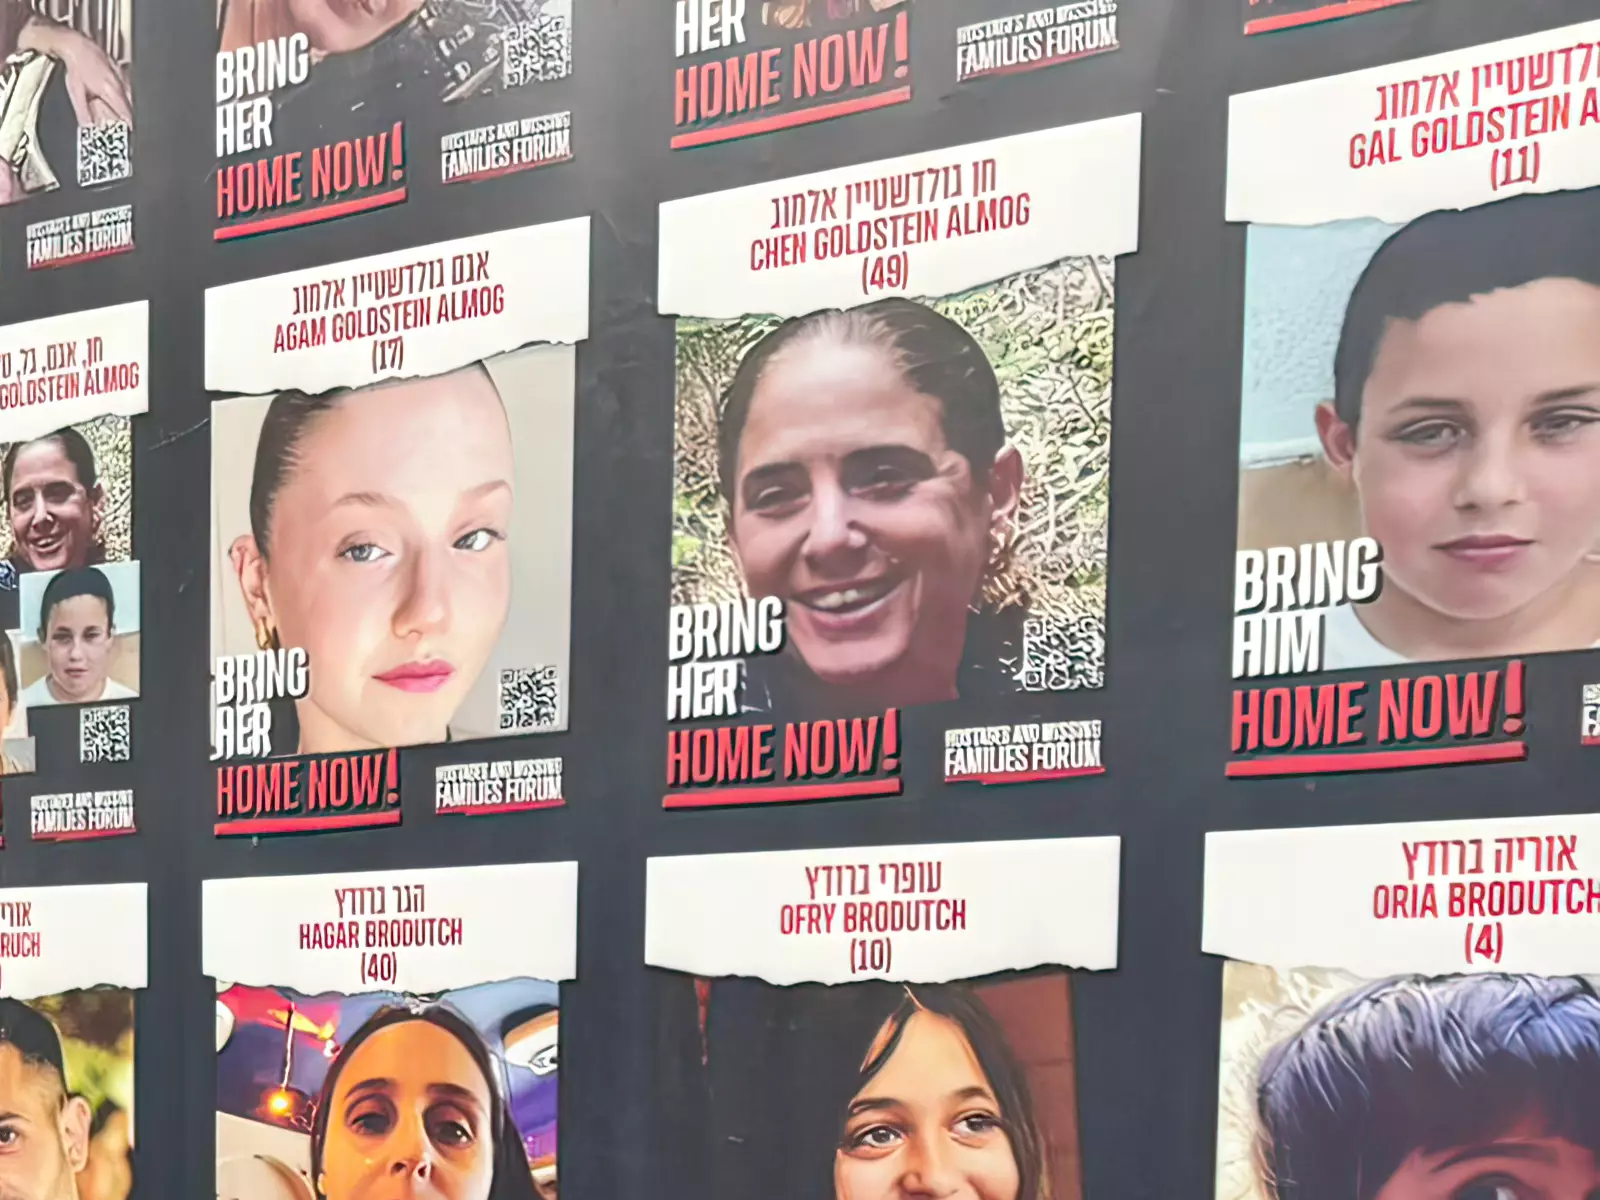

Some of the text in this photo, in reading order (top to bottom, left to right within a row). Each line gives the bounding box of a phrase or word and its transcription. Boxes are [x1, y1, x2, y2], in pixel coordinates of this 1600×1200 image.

[676, 0, 745, 56] HER
[958, 29, 1043, 81] FAMILIES
[1047, 14, 1117, 56] FORUM
[216, 34, 309, 101] BRING
[676, 48, 780, 125] HOME
[795, 13, 908, 95] NOW!
[216, 103, 273, 156] HER
[442, 145, 510, 179] FAMILIES
[512, 130, 570, 165] FORUM
[1349, 94, 1571, 170] GAL GOLDSTEIN
[217, 153, 301, 217] HOME
[313, 122, 405, 200] NOW!
[1490, 142, 1541, 191] (11)
[27, 220, 133, 268] FAMILIES FORUM
[750, 193, 1030, 271] CHEN GOLDSTEIN ALMOG
[861, 251, 909, 294] (49)
[273, 284, 505, 353] AGAM GOLDSTEIN ALMOG
[83, 361, 140, 396] ALMOG
[371, 335, 404, 373] (17)
[1236, 537, 1381, 612] BRING
[669, 597, 784, 659] BRING
[1232, 610, 1322, 677] HIM
[668, 659, 740, 718] HER
[1232, 662, 1525, 752] HOME NOW!
[780, 898, 966, 935] OFRY BRODUTCH
[1373, 878, 1600, 919] ORIA BRODUTCH
[299, 917, 463, 950] HAGAR BRODUTCH
[850, 937, 892, 974] (10)
[1464, 922, 1504, 963] (4)
[360, 951, 398, 985] (40)
